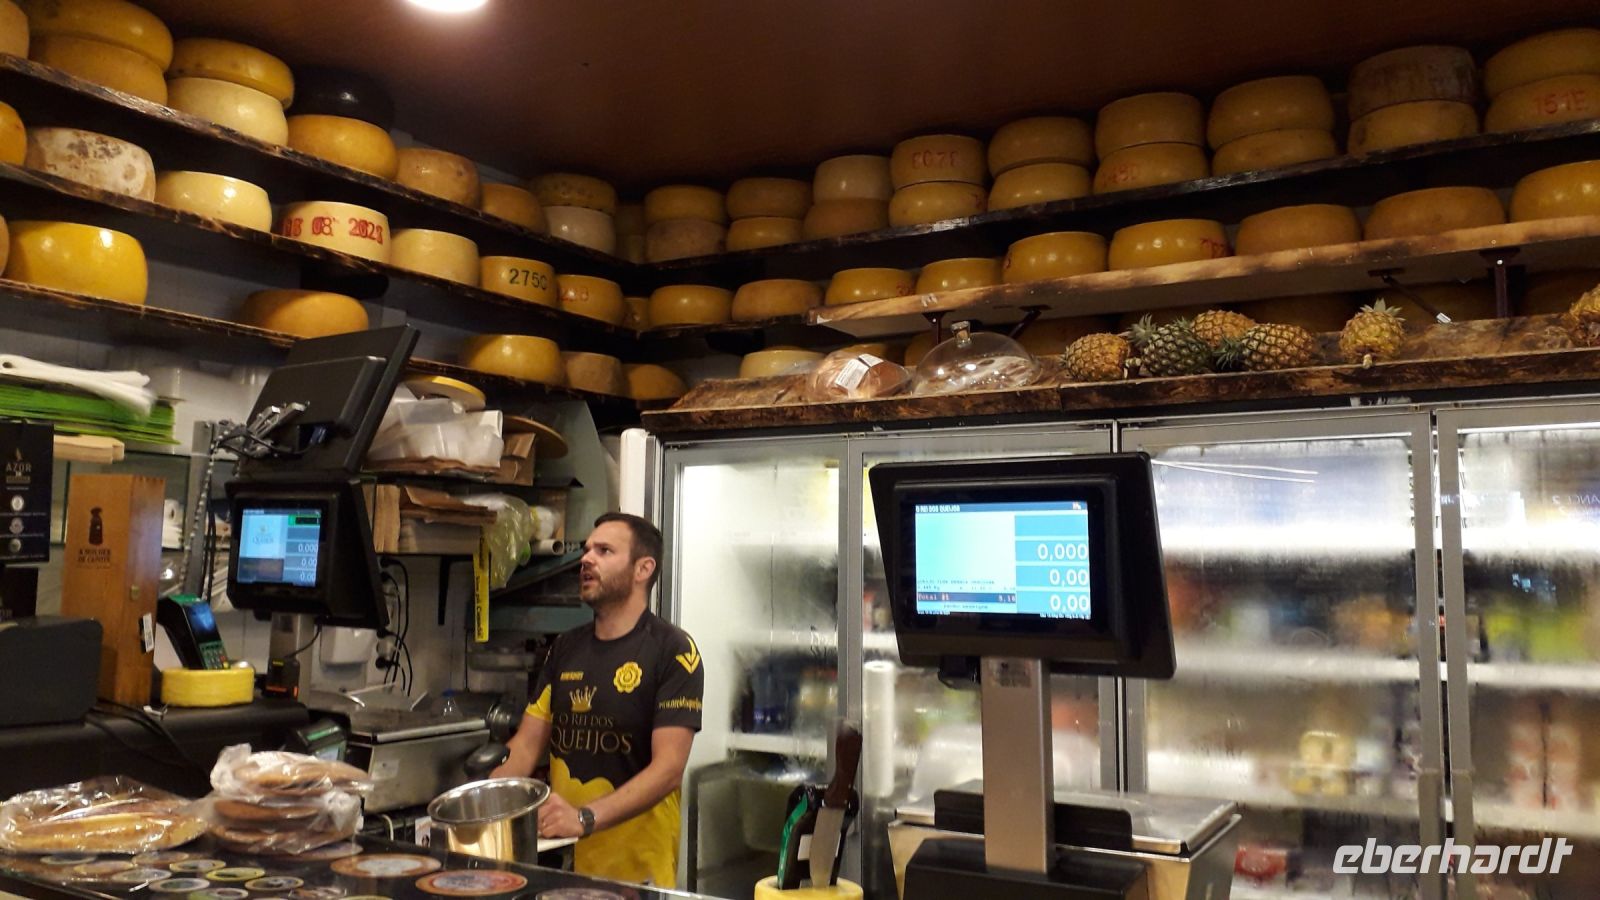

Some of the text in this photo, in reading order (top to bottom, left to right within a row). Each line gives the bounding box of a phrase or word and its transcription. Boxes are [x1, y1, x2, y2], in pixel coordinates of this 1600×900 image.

[1037, 543, 1089, 561] 0,000
[1049, 568, 1089, 587] 0,00
[1050, 594, 1090, 613] 0,00
[590, 714, 614, 728] DOS
[551, 727, 632, 755] QUEIJOS
